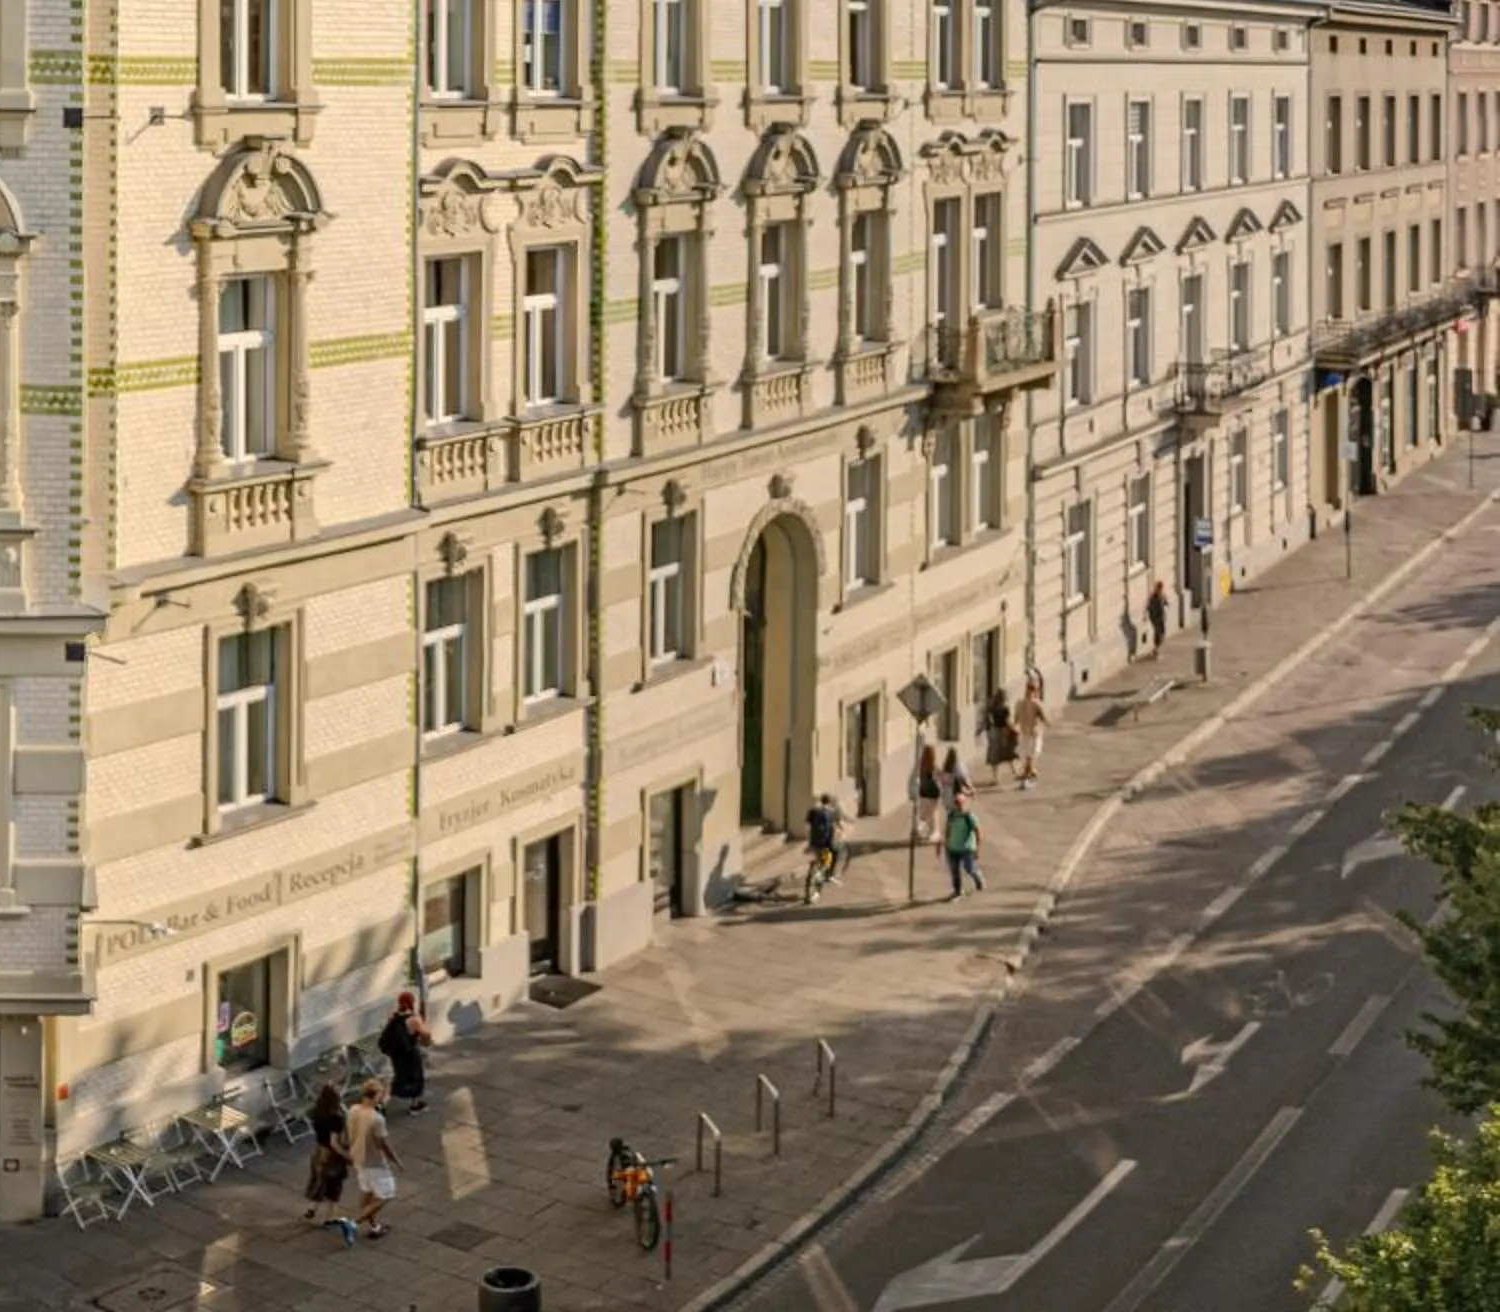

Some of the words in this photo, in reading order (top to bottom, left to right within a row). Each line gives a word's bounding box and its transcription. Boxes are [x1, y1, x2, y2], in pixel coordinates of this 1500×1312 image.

[166, 912, 199, 931] Bar
[202, 900, 220, 923] &
[289, 851, 365, 894] Recepcja
